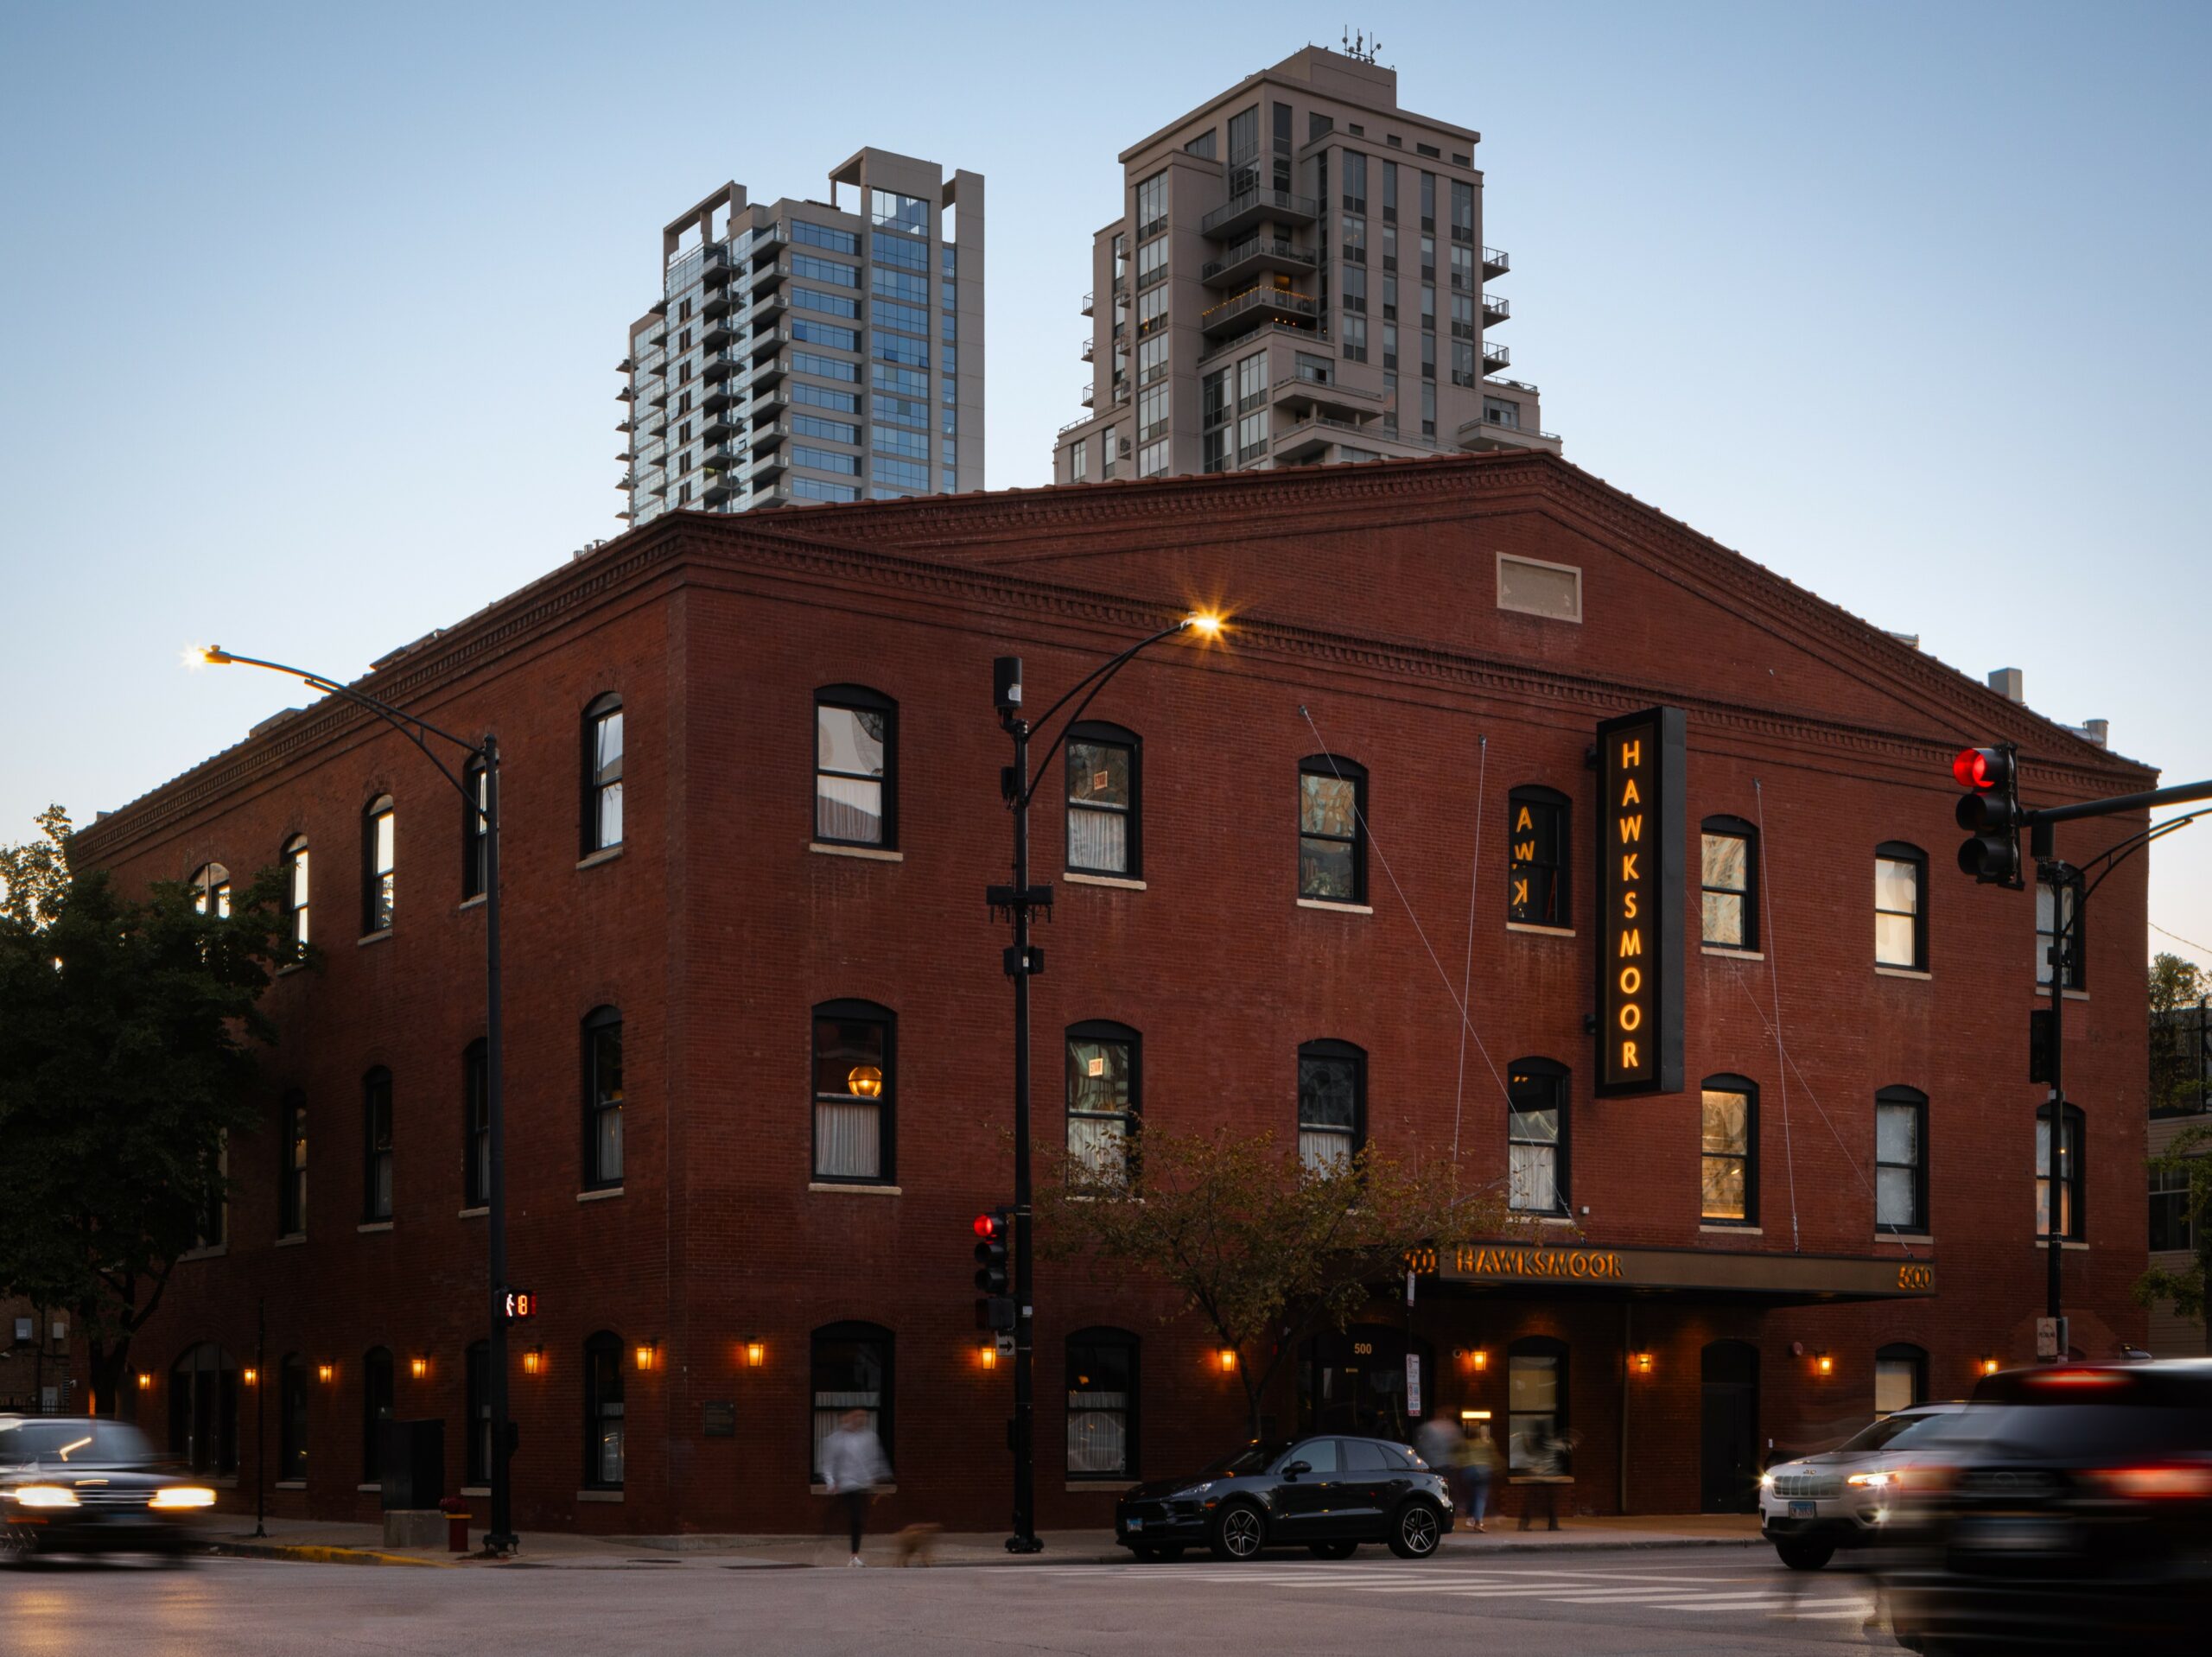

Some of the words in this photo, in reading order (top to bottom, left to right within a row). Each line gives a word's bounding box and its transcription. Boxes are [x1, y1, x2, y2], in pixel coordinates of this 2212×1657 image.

[1619, 740, 1642, 1069] HAWKSMOOR
[1457, 1249, 1624, 1278] HAWKSMOOR
[1897, 1266, 1932, 1290] 500
[1354, 1343, 1372, 1355] 500
